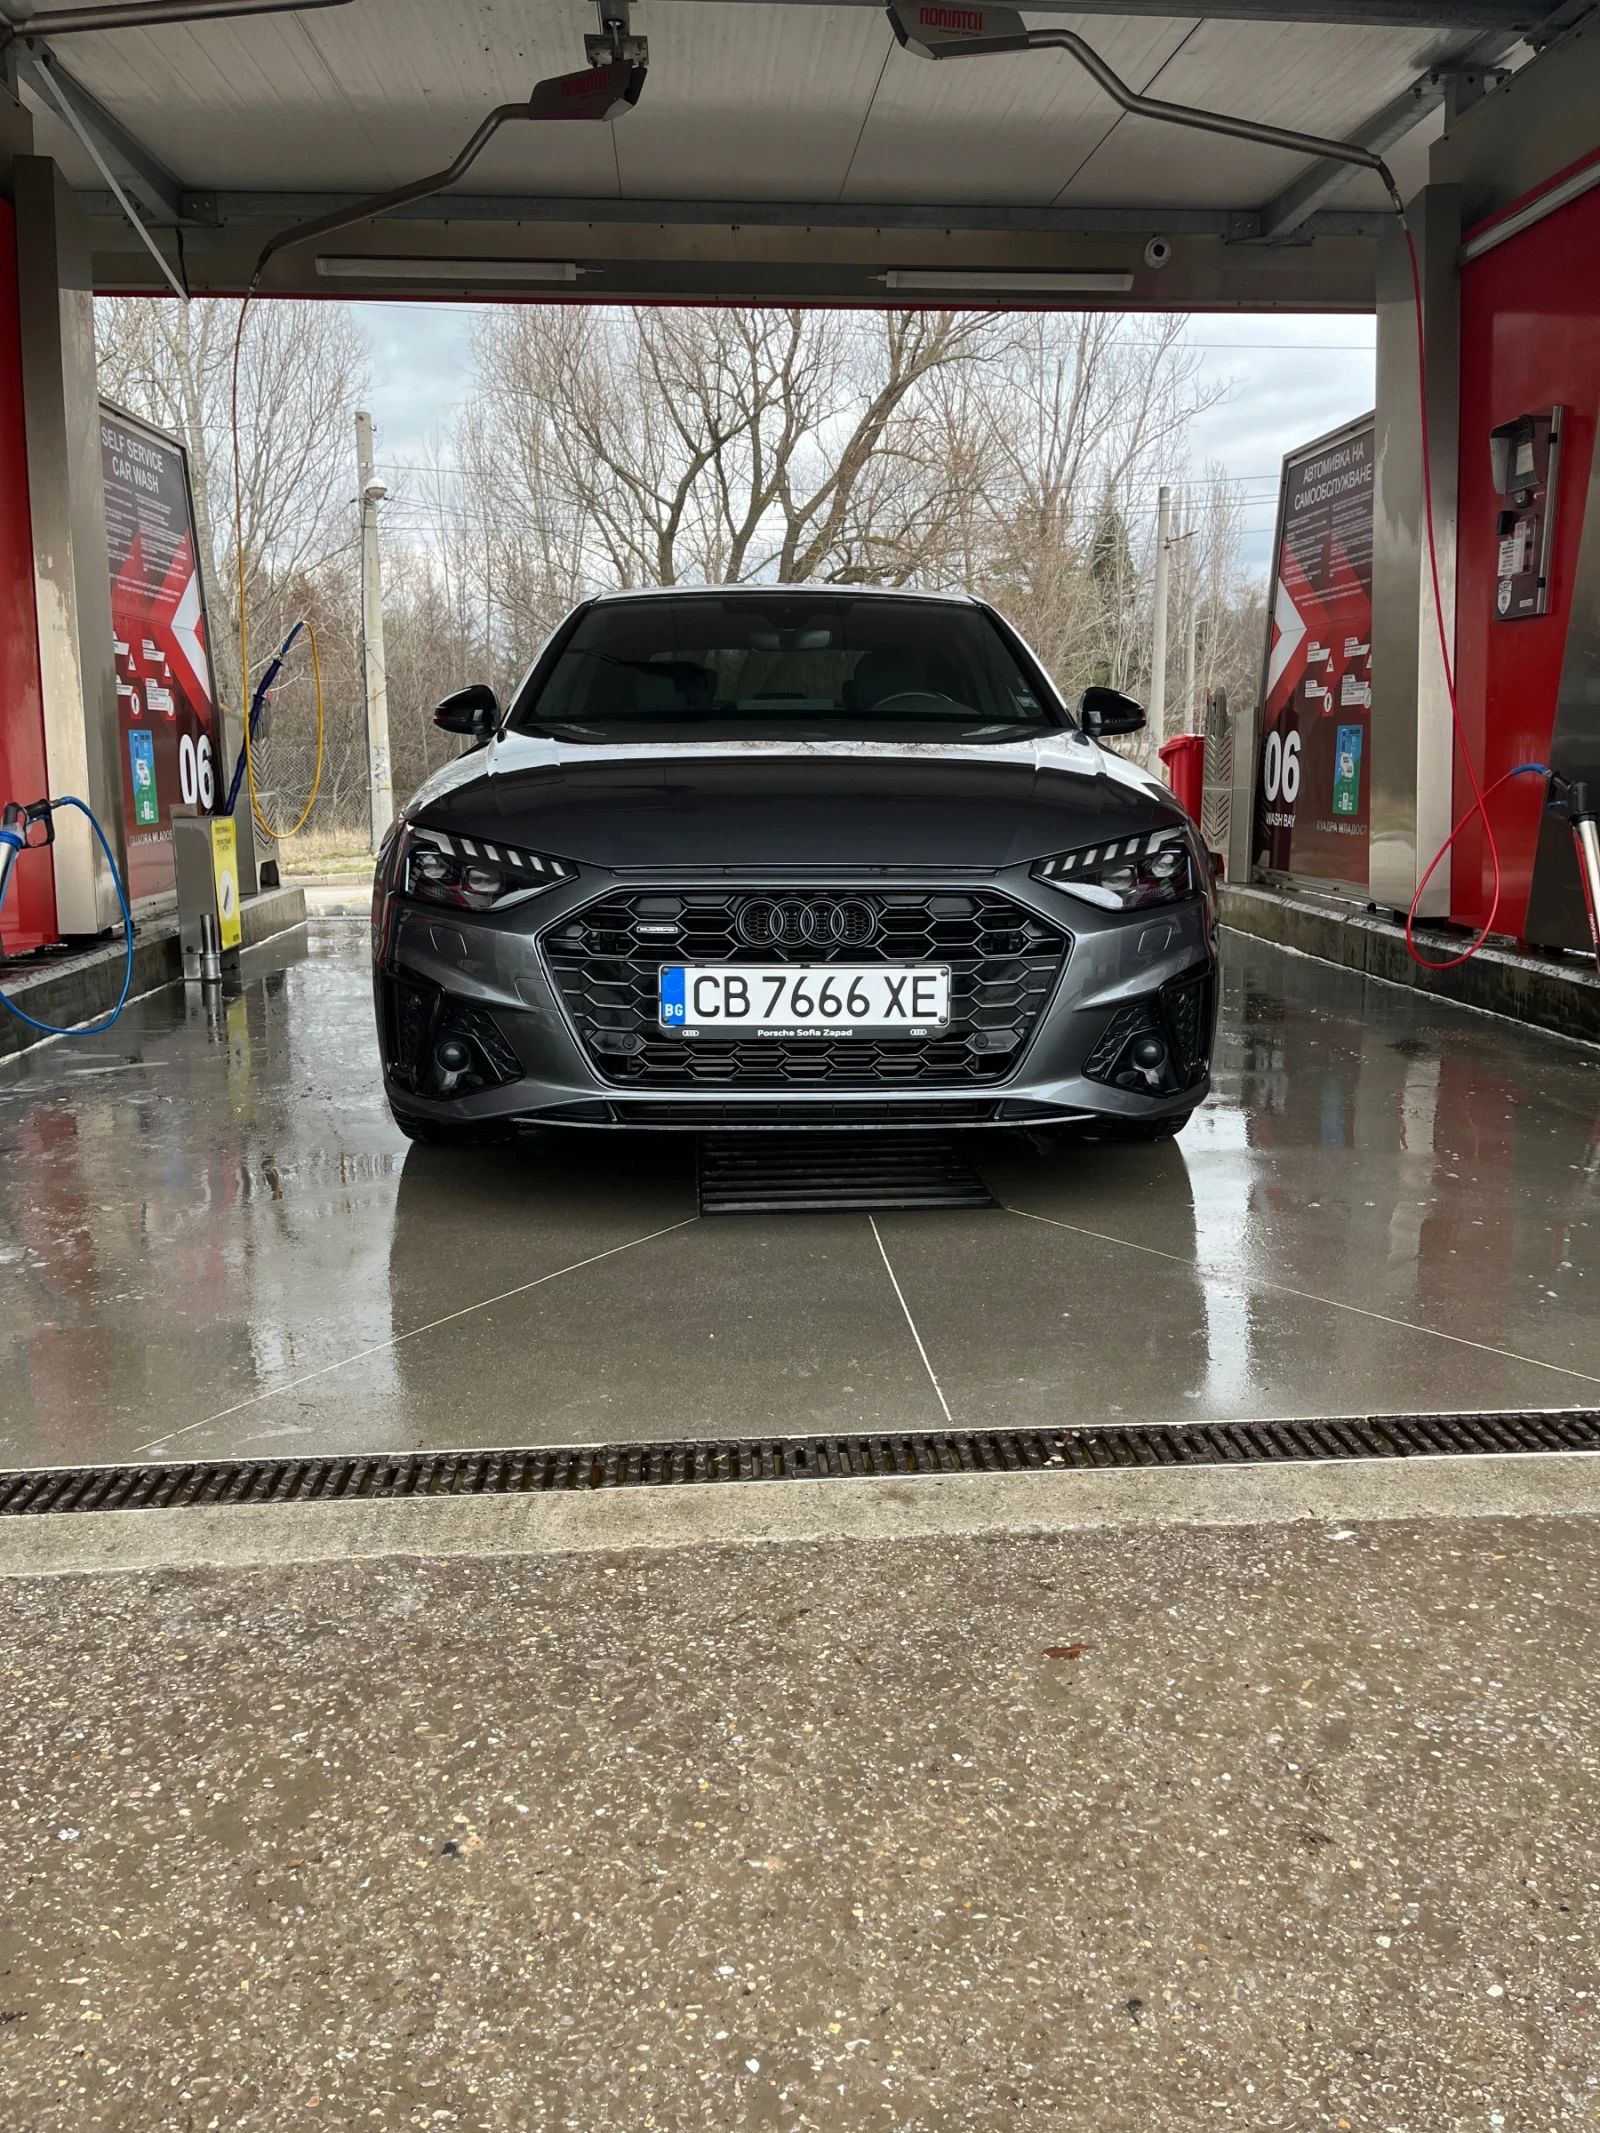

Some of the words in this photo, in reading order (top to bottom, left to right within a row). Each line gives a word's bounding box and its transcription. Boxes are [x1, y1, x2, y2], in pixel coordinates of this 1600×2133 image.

[101, 425, 124, 453] SELF
[126, 438, 164, 473] SERVICE
[1303, 450, 1350, 484] АВТОМИВКА
[1352, 443, 1365, 462] НА
[112, 456, 132, 482] CAR
[132, 465, 159, 494] WASH
[1294, 463, 1373, 510] САМООБСЛУЖВАНЕ
[179, 734, 215, 809] 06
[1264, 730, 1301, 803] 06
[1265, 812, 1283, 827] WASH
[1283, 813, 1296, 828] BAY
[1316, 820, 1338, 834] КУАДРА
[1338, 822, 1368, 837] МЛАДОСТ
[664, 1003, 684, 1017] BG
[693, 975, 751, 1018] CB
[761, 975, 870, 1018] 7666
[882, 975, 938, 1018] XE
[757, 1028, 795, 1037] Porsche
[796, 1028, 821, 1037] Sofia
[823, 1028, 853, 1039] Zapad
